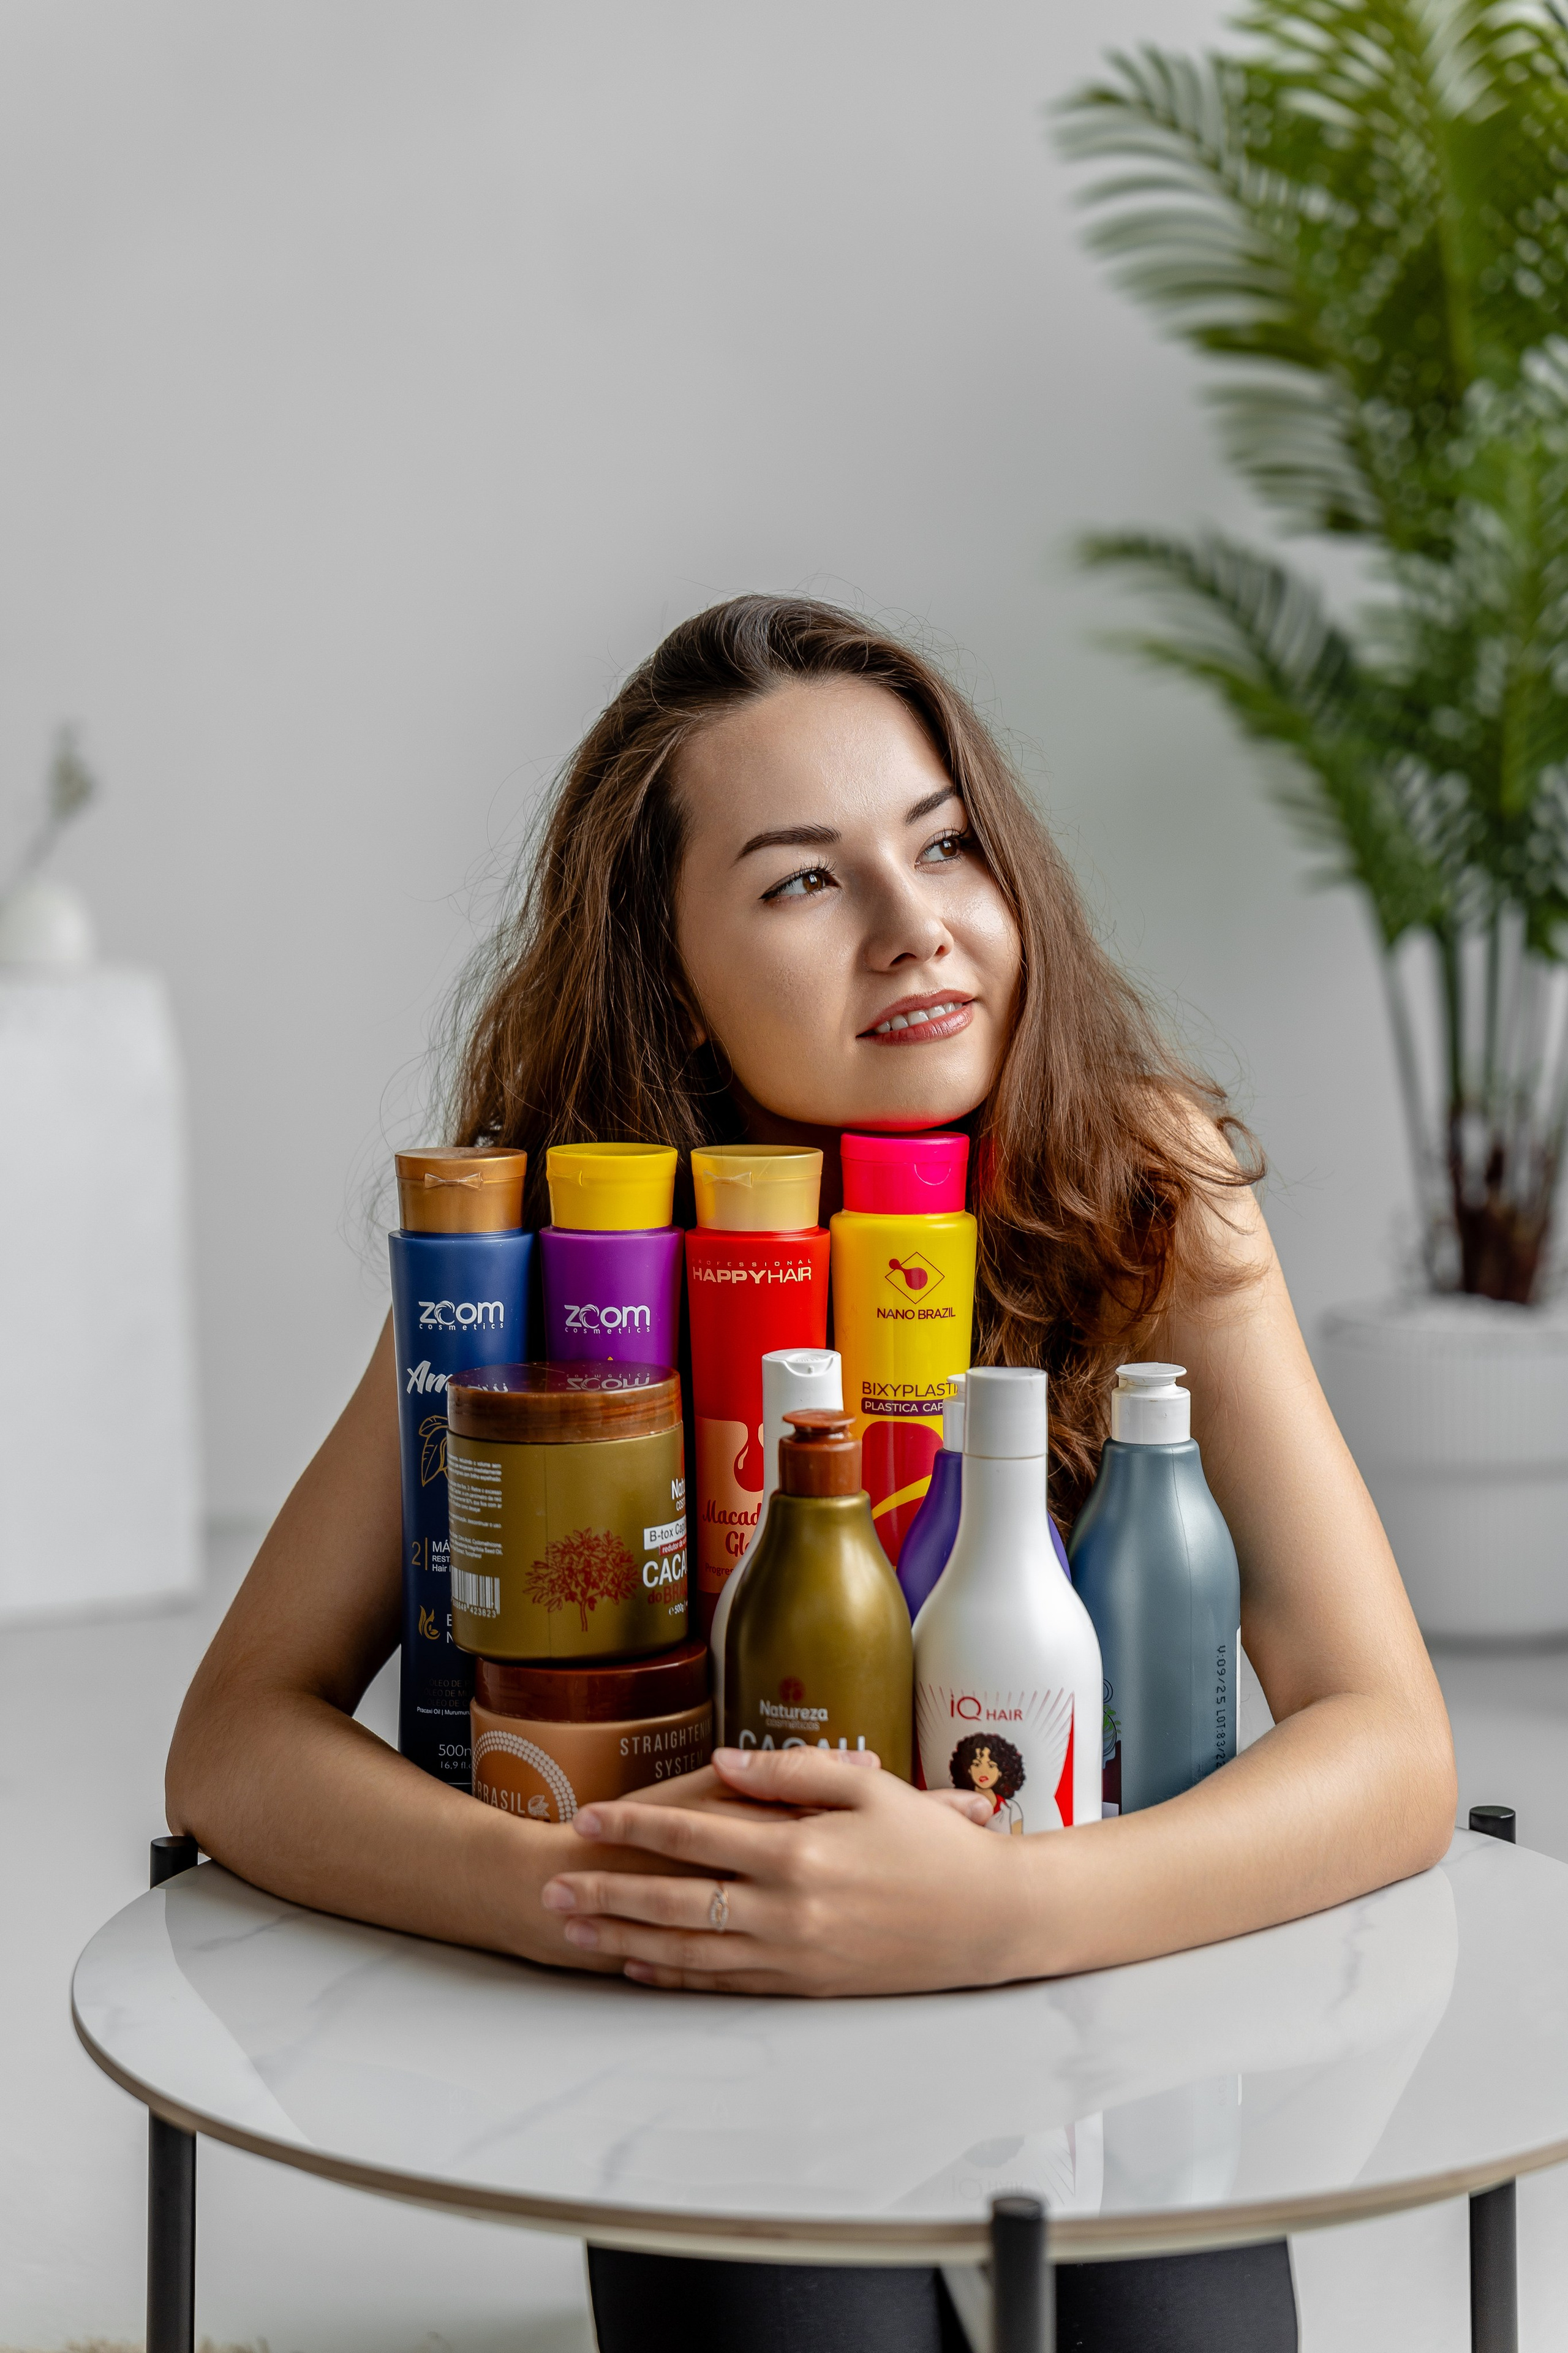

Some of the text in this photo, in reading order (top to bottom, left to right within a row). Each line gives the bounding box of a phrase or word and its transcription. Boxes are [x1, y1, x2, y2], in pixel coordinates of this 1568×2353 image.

[692, 1258, 812, 1267] PROFESSIONAL
[877, 1307, 956, 1320] NANO BRAZIL
[862, 1381, 957, 1397] BIXYPLASTI
[865, 1401, 918, 1413] PLASTICA
[650, 1528, 674, 1542] B-tox
[412, 1541, 421, 1566] 2
[643, 1547, 687, 1588] CACA
[760, 1699, 829, 1721] Natureza
[986, 1709, 1023, 1720] HAIR
[477, 1780, 526, 1813] BRASIL
